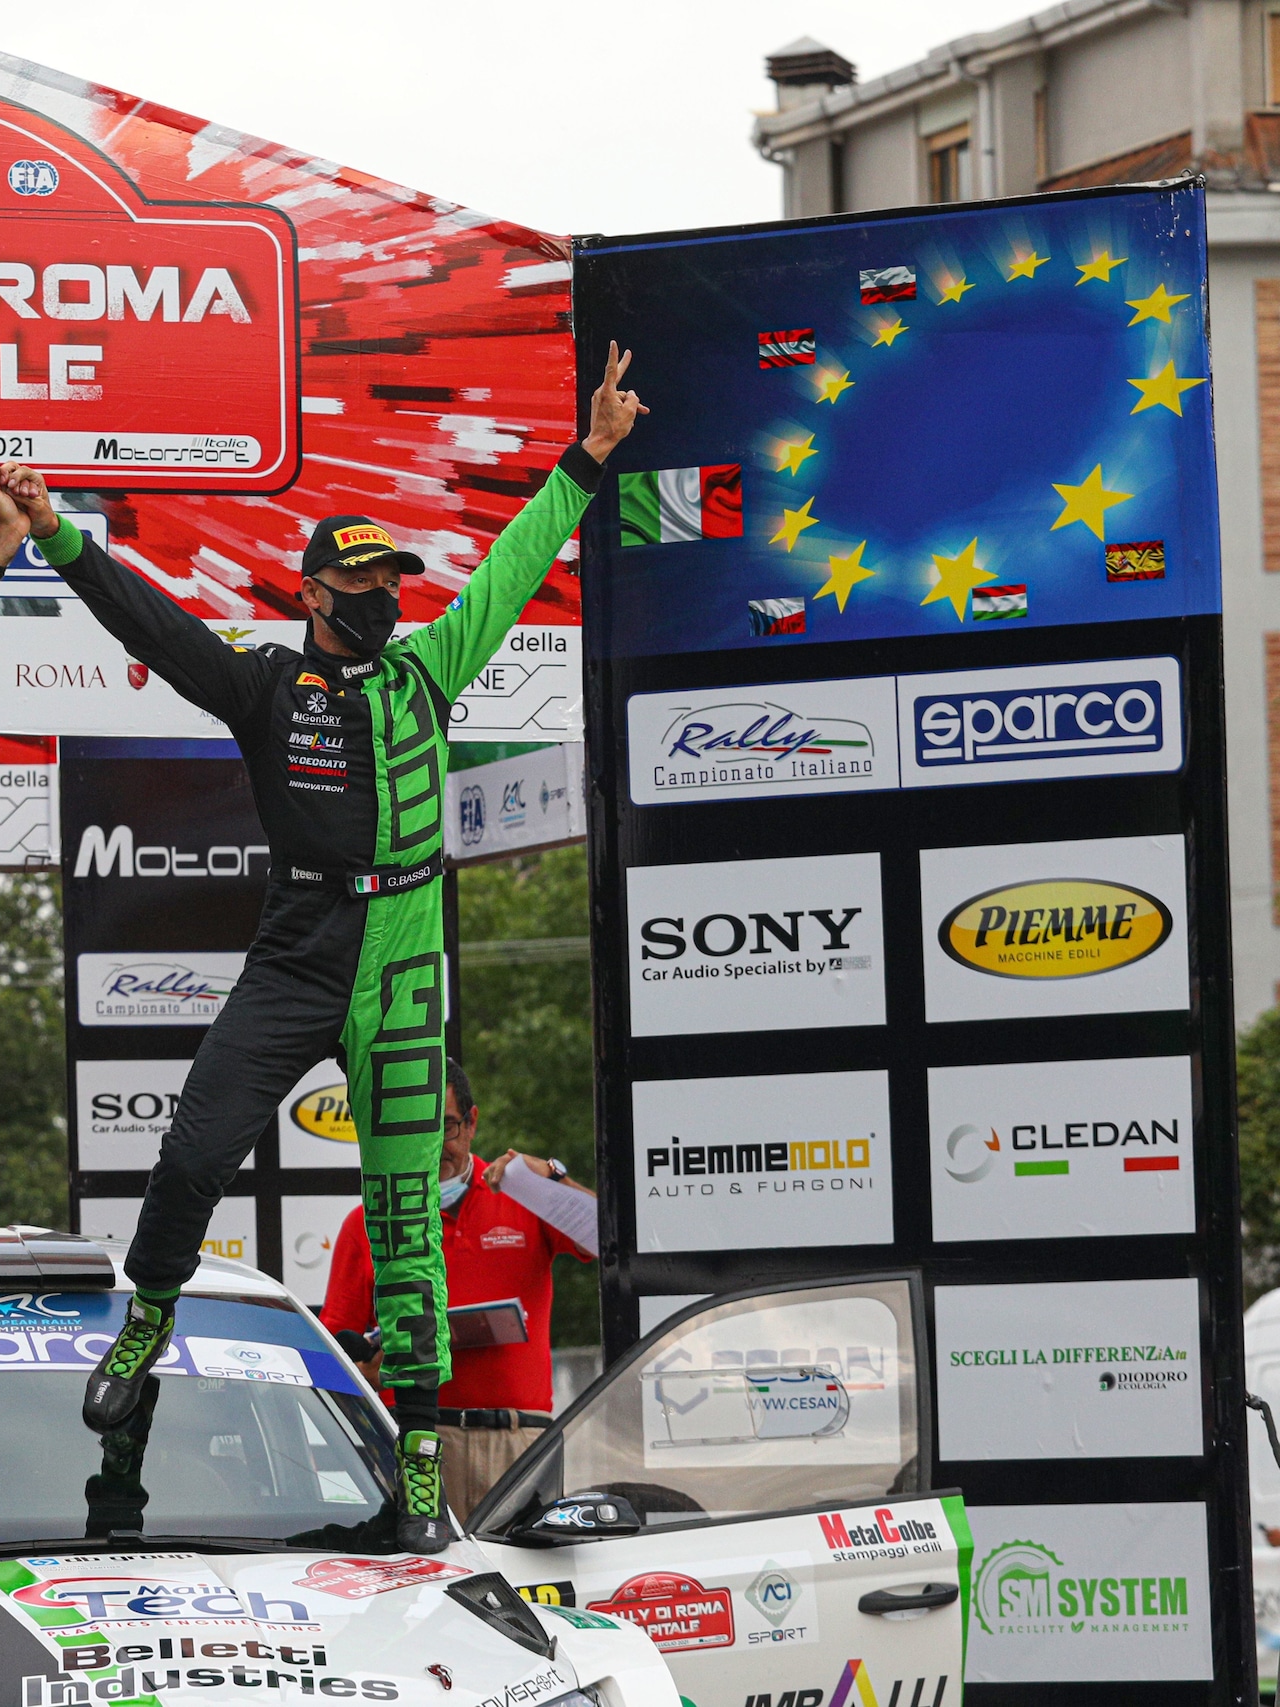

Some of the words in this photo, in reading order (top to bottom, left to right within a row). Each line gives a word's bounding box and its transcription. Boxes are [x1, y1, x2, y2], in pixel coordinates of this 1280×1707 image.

[94, 438, 250, 463] Motorsport
[205, 437, 249, 448] Italia
[510, 632, 568, 652] della
[15, 664, 108, 689] ROMA
[341, 661, 374, 679] freem
[292, 711, 342, 726] BIGonDRY
[921, 689, 1156, 761] sparco
[669, 713, 820, 760] Rally
[299, 756, 347, 769] CECCATO
[654, 762, 775, 788] Campionato
[790, 758, 873, 778] Italiano
[288, 780, 345, 793] INNOVATECH
[291, 866, 322, 882] freem
[387, 866, 431, 887] G.BASSO
[641, 908, 862, 960] SONY
[974, 902, 1137, 949] PIEMME
[997, 949, 1065, 963] MACCHINE
[1068, 947, 1102, 960] EDILI
[642, 966, 668, 981] Car
[672, 963, 720, 980] Audio
[723, 959, 803, 980] Specialist
[806, 959, 827, 976] by
[107, 971, 209, 1002] Rally
[96, 1000, 180, 1016] Campionato
[91, 1124, 110, 1134] Car
[113, 1123, 146, 1134] Audio
[1011, 1118, 1180, 1151] CLEDAN
[647, 1184, 716, 1199] AUTO
[729, 1182, 743, 1195] &
[757, 1177, 874, 1193] FURGONI
[41, 1318, 82, 1326] RALLY
[239, 1351, 261, 1361] ACI
[950, 1350, 1018, 1367] SCEGLI
[1022, 1349, 1048, 1365] LA
[204, 1366, 304, 1384] SPORT
[1117, 1371, 1188, 1383] DIODORO
[93, 1380, 111, 1404] freem
[1117, 1382, 1167, 1390] ECOLOGIA
[817, 1508, 938, 1549] MetalColbe
[833, 1545, 909, 1562] stampaggi
[914, 1541, 943, 1555] edili
[138, 1584, 237, 1597] Main
[347, 1569, 460, 1597] COMPETITOR
[762, 1583, 792, 1603] ACI
[58, 1590, 310, 1621] Tech
[1057, 1577, 1188, 1618] SYSTEM
[654, 1605, 672, 1619] DI
[675, 1600, 725, 1618] ROMA
[47, 1620, 151, 1637] PLASTICS
[164, 1619, 322, 1632] ENGINEERING
[747, 1626, 808, 1644] SPORT
[999, 1624, 1065, 1635] FACILITY
[1091, 1623, 1190, 1634] MANAGEMENT
[61, 1637, 328, 1672] Belletti
[22, 1664, 400, 1701] Industries
